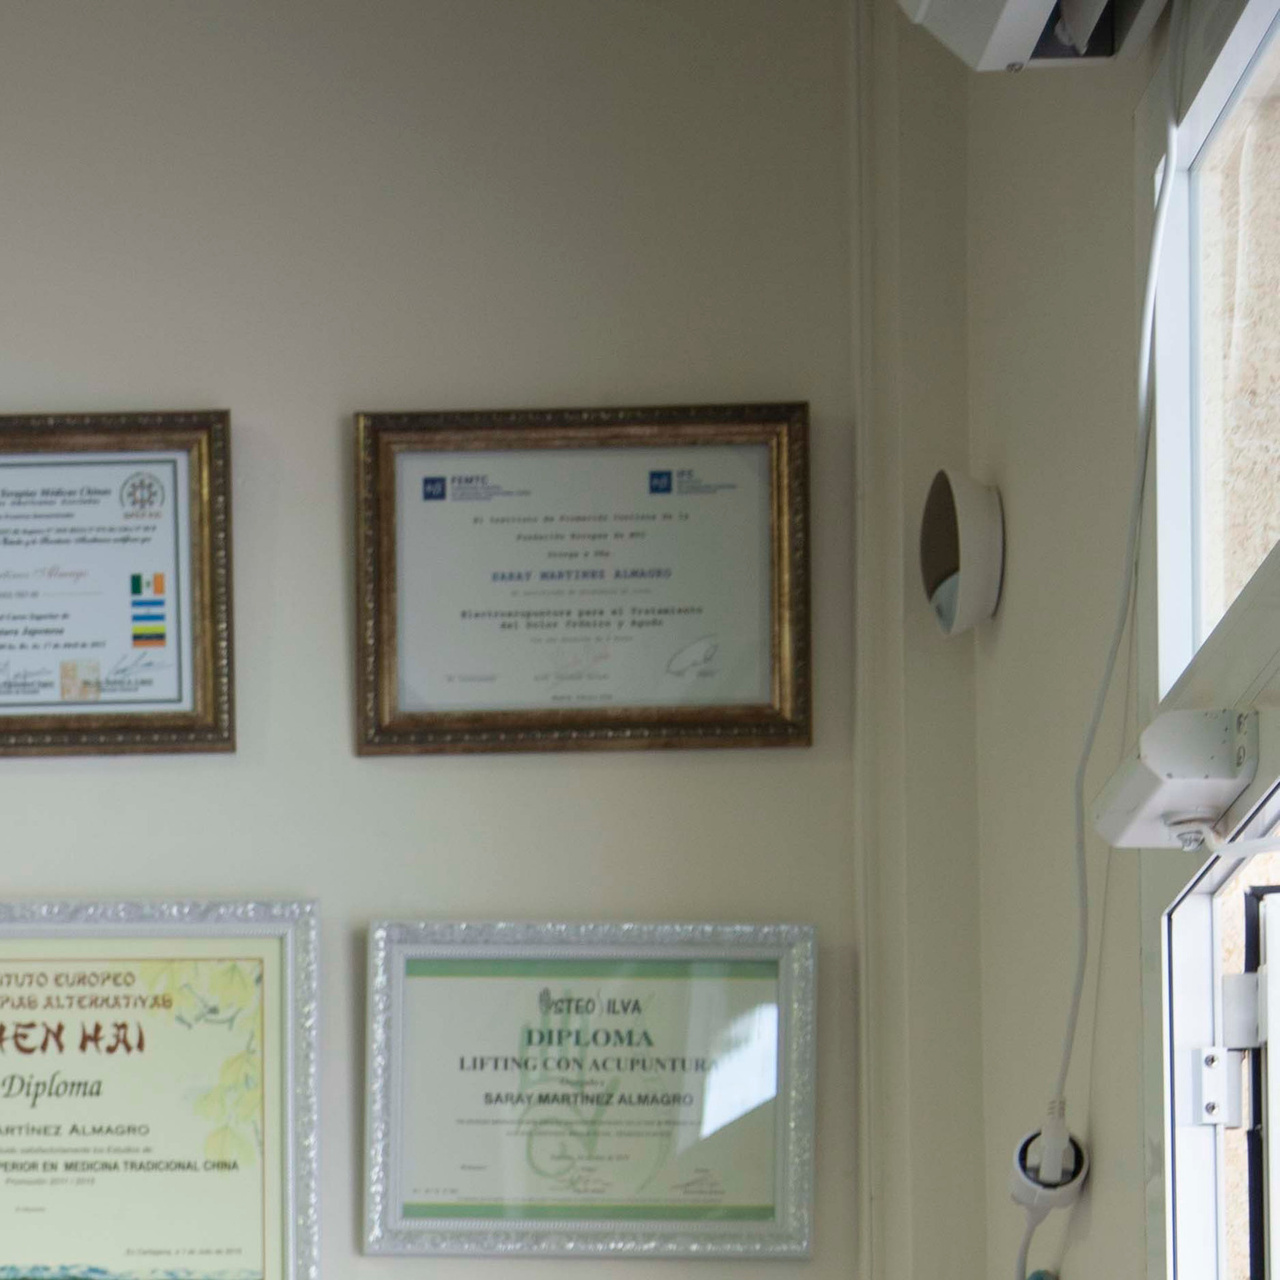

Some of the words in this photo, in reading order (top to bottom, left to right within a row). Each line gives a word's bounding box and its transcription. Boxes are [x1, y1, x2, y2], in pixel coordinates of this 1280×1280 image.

[53, 970, 136, 988] EUROPEO
[42, 993, 174, 1011] ALTERNATIVAS
[78, 1019, 147, 1056] HAI
[525, 1027, 655, 1049] DIPLOMA
[458, 1056, 538, 1073] LIFTING
[542, 1056, 584, 1073] CON
[0, 1070, 103, 1110] Diploma
[484, 1092, 534, 1106] SARAY
[617, 1092, 695, 1106] ALMAGRO
[41, 1159, 59, 1173] EN
[64, 1158, 120, 1173] MEDICINA
[123, 1158, 200, 1173] TRADICIONAL
[203, 1159, 239, 1172] CHINA
